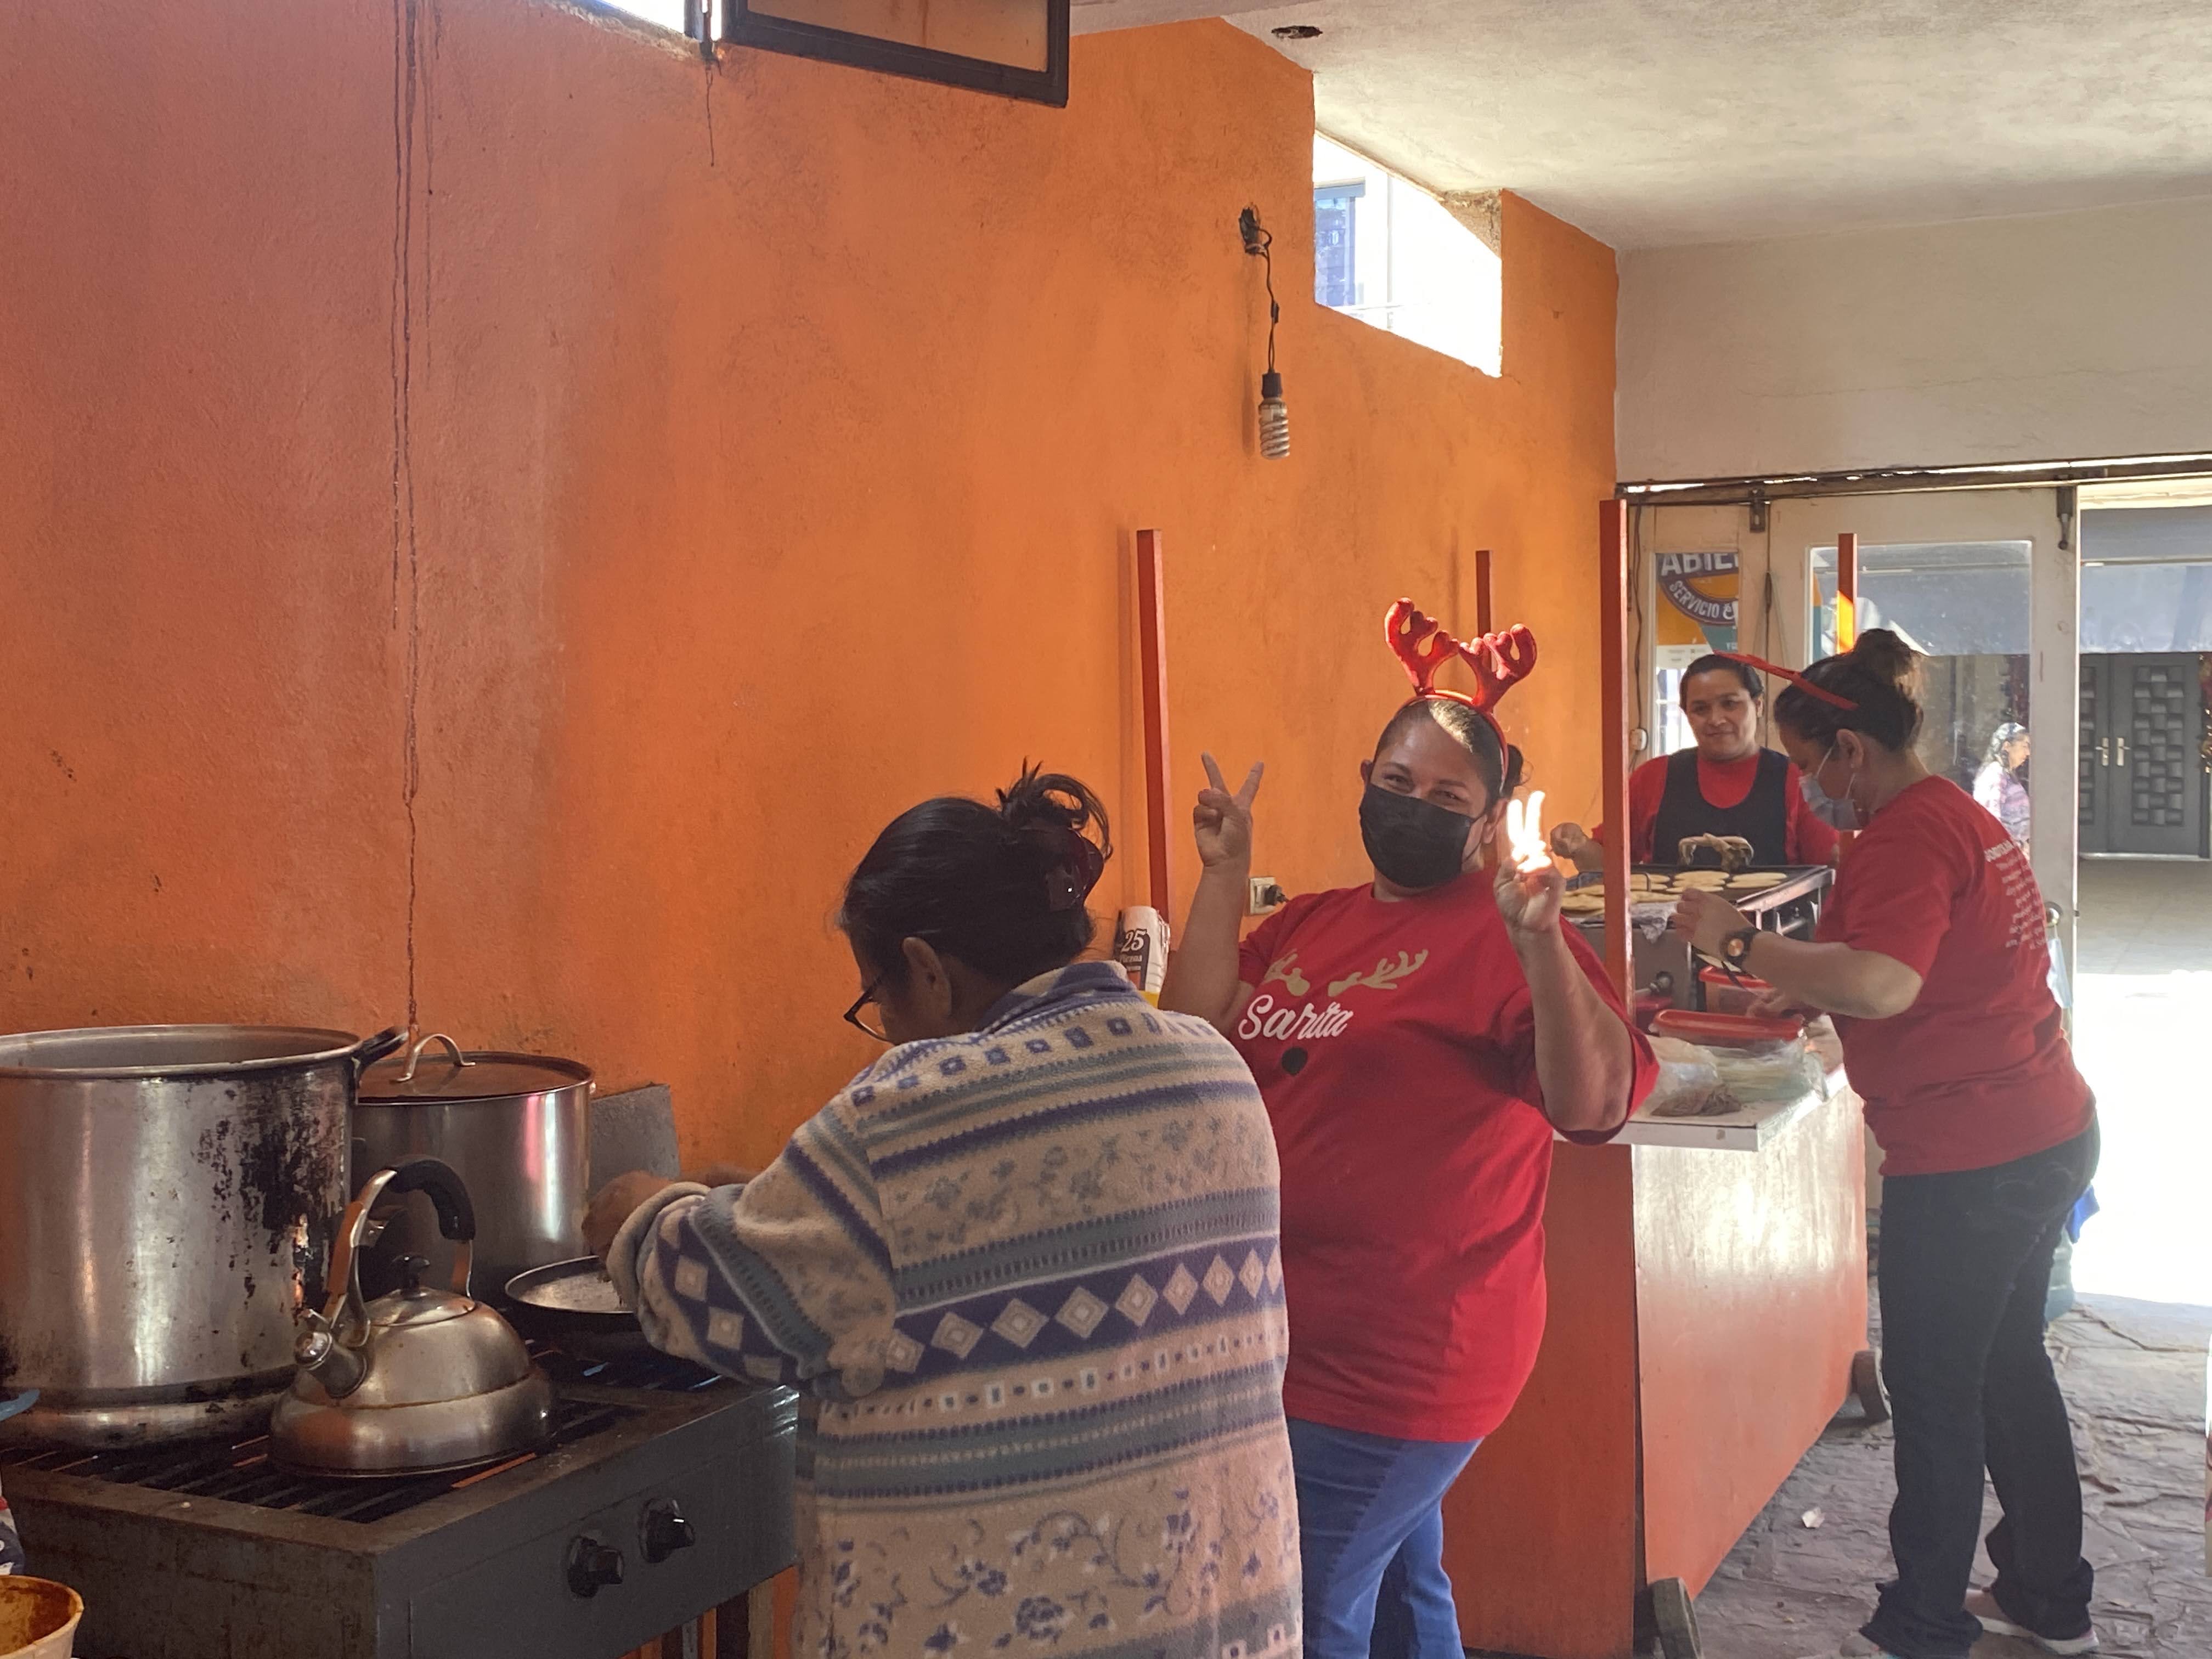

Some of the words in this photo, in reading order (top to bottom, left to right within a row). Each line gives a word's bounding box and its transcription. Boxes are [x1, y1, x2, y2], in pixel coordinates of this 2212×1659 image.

[1661, 553, 1738, 577] ABIE
[1669, 580, 1720, 618] SERVICIO
[1121, 928, 1147, 952] 25
